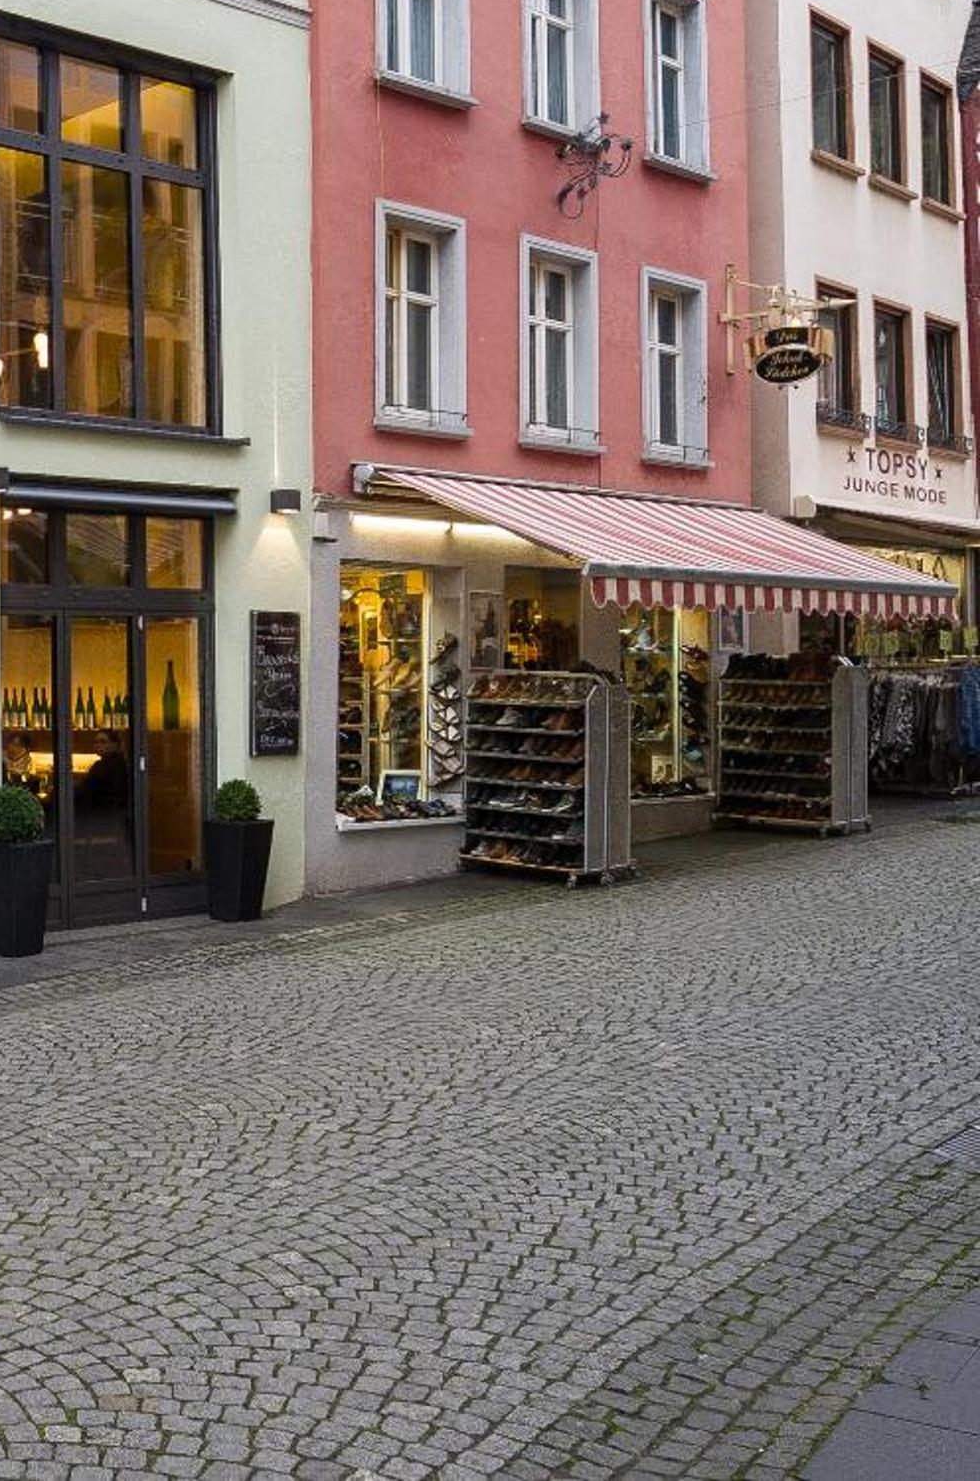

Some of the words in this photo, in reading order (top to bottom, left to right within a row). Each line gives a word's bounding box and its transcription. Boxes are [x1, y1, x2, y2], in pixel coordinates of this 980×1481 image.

[865, 447, 928, 480] TOPSY
[844, 476, 899, 498] JUNGE
[904, 485, 947, 504] MODE
